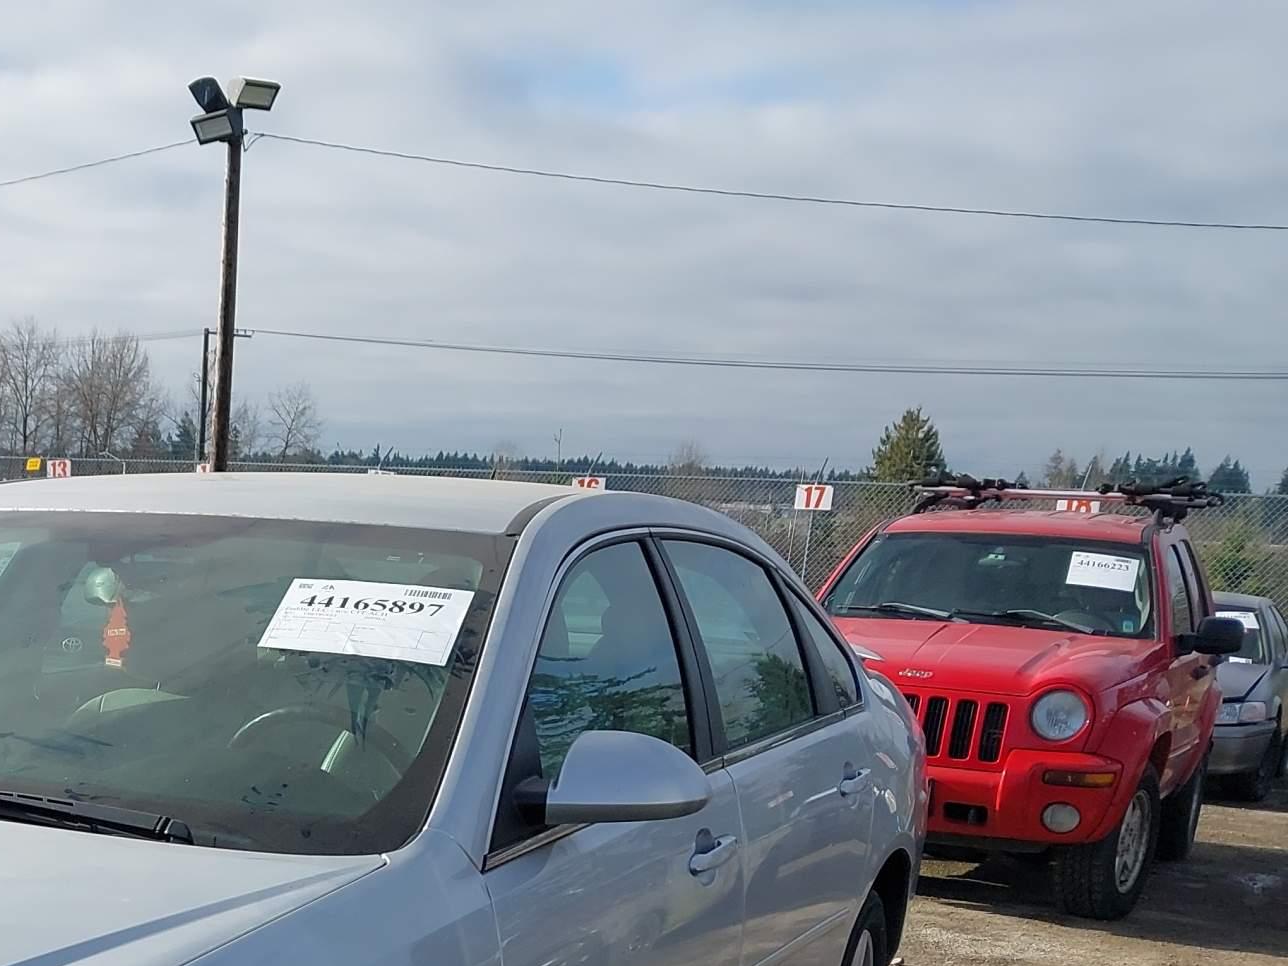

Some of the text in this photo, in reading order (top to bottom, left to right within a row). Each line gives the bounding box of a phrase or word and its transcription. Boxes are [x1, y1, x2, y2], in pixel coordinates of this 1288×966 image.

[51, 461, 67, 477] 13
[804, 486, 826, 509] 17
[1077, 559, 1130, 572] 44166223
[300, 595, 444, 617] 44165897
